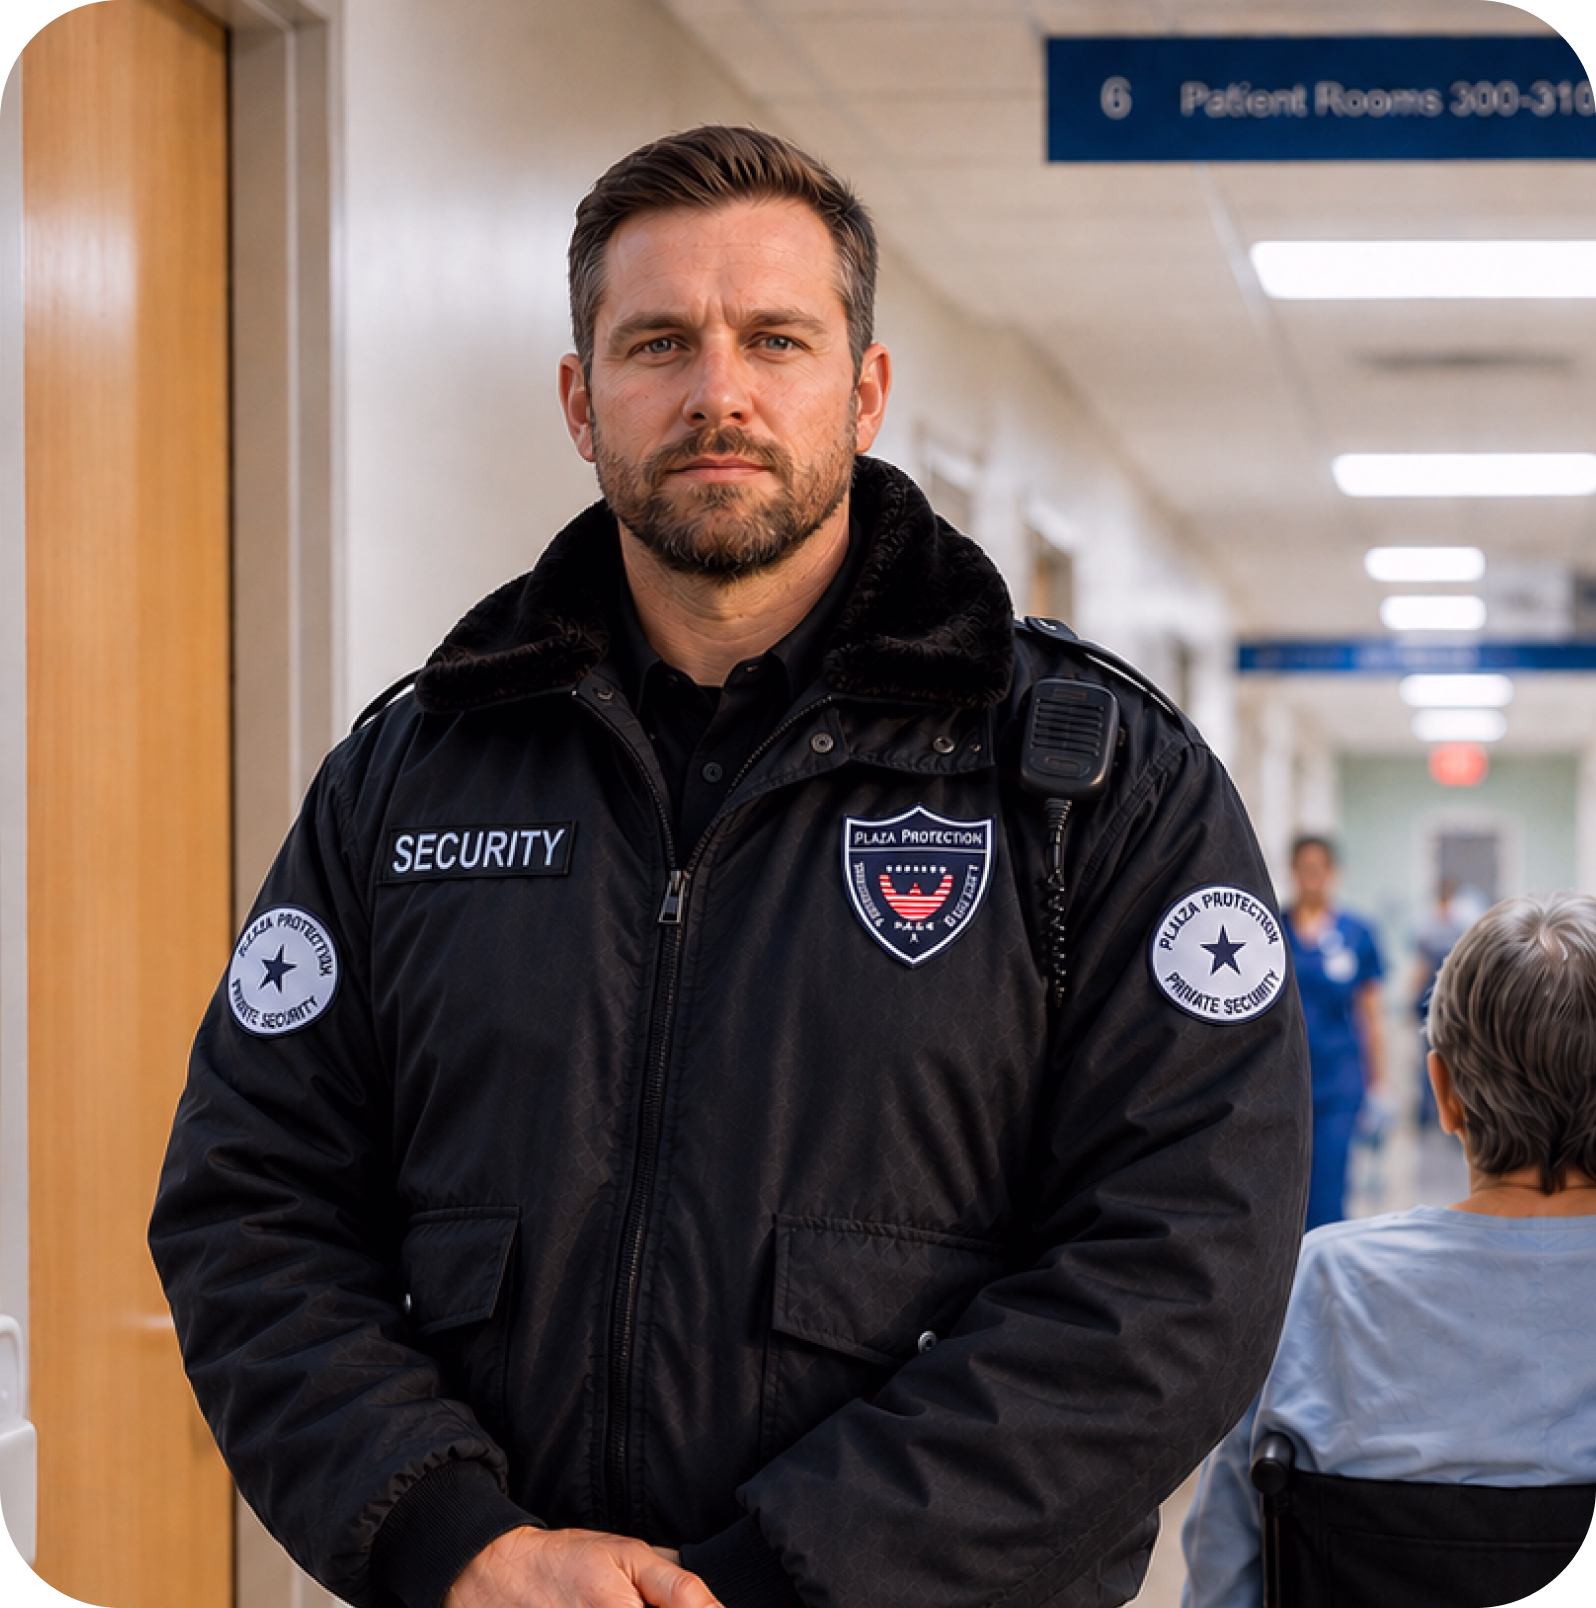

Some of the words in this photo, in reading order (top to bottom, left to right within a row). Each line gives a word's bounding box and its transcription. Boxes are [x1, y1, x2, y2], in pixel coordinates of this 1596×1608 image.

[1100, 76, 1132, 120] 6
[1180, 81, 1308, 118] Patient
[1315, 81, 1443, 118] Rooms
[392, 829, 565, 873] SECURITY
[1159, 901, 1201, 951] PLAZA
[1201, 892, 1279, 945] PROTECTION
[1223, 968, 1280, 1015] SECURITY
